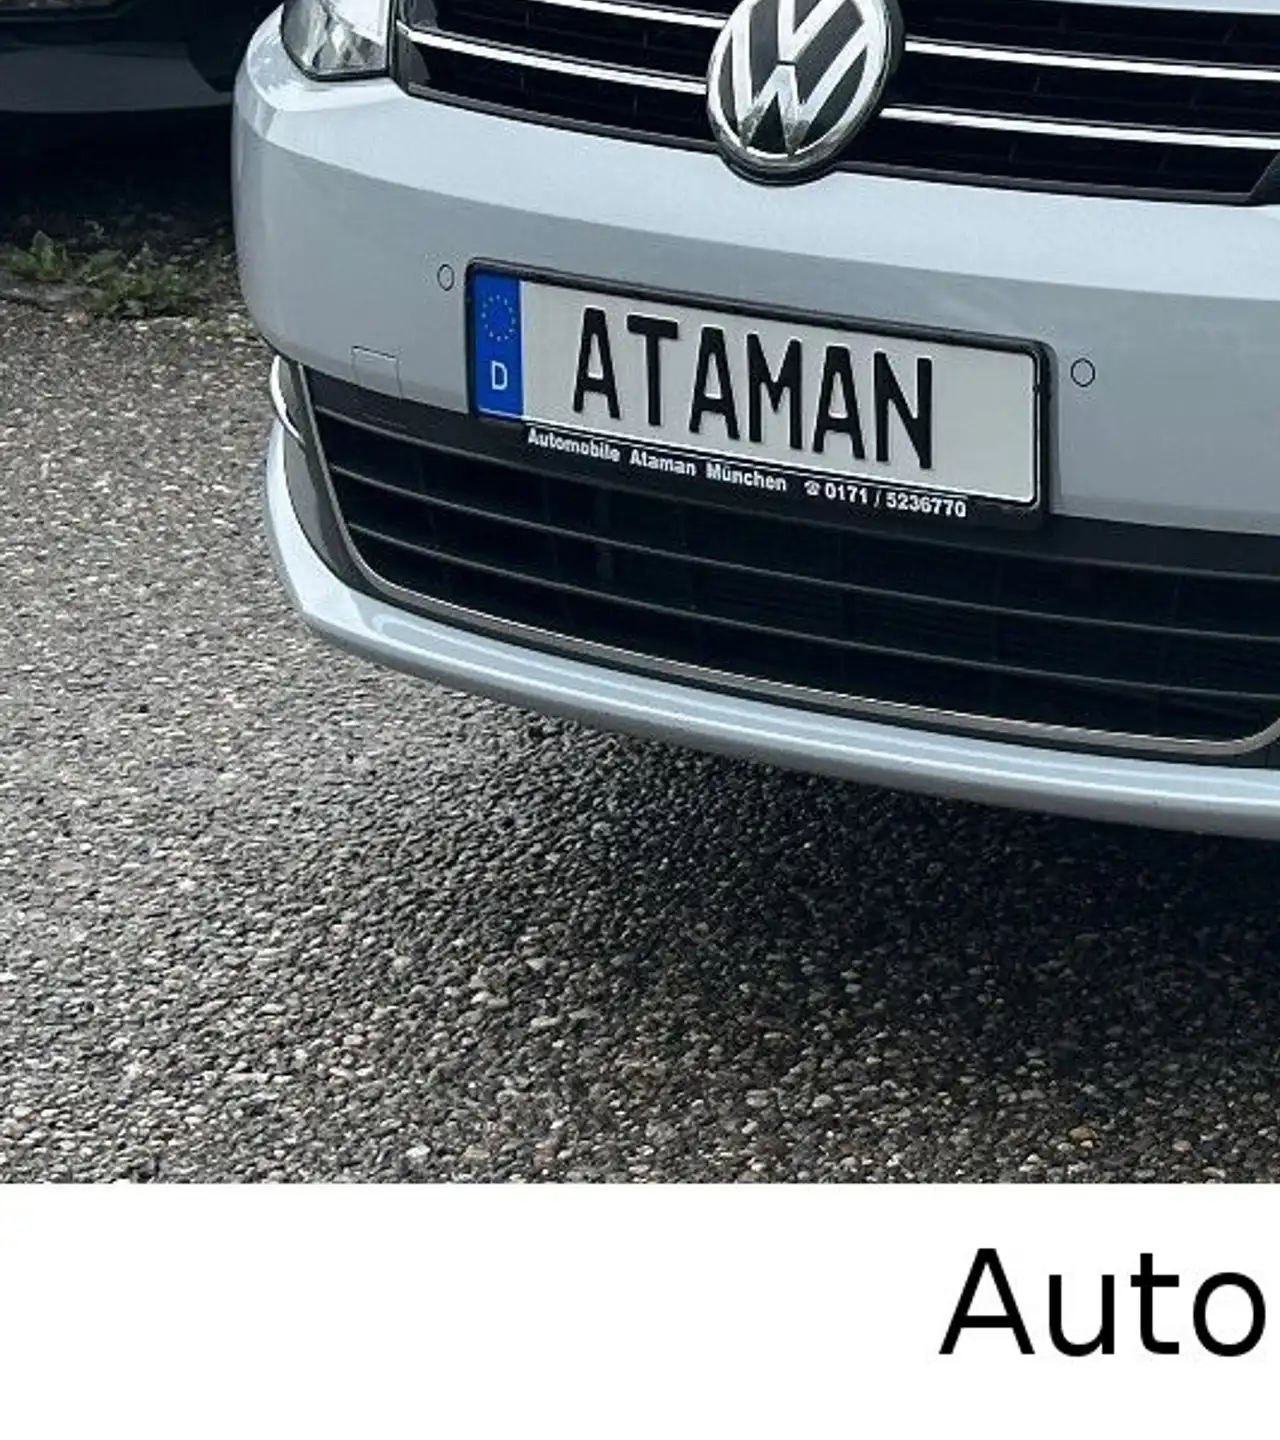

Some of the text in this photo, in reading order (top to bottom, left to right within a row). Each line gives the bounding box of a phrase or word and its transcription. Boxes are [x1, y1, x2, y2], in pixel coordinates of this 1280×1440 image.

[490, 360, 508, 391] D
[571, 306, 934, 470] ATAMAN
[527, 427, 621, 463] Automobile
[630, 447, 697, 478] Ataman
[706, 462, 787, 493] München
[824, 481, 869, 507] 0171
[886, 490, 968, 519] 5236770
